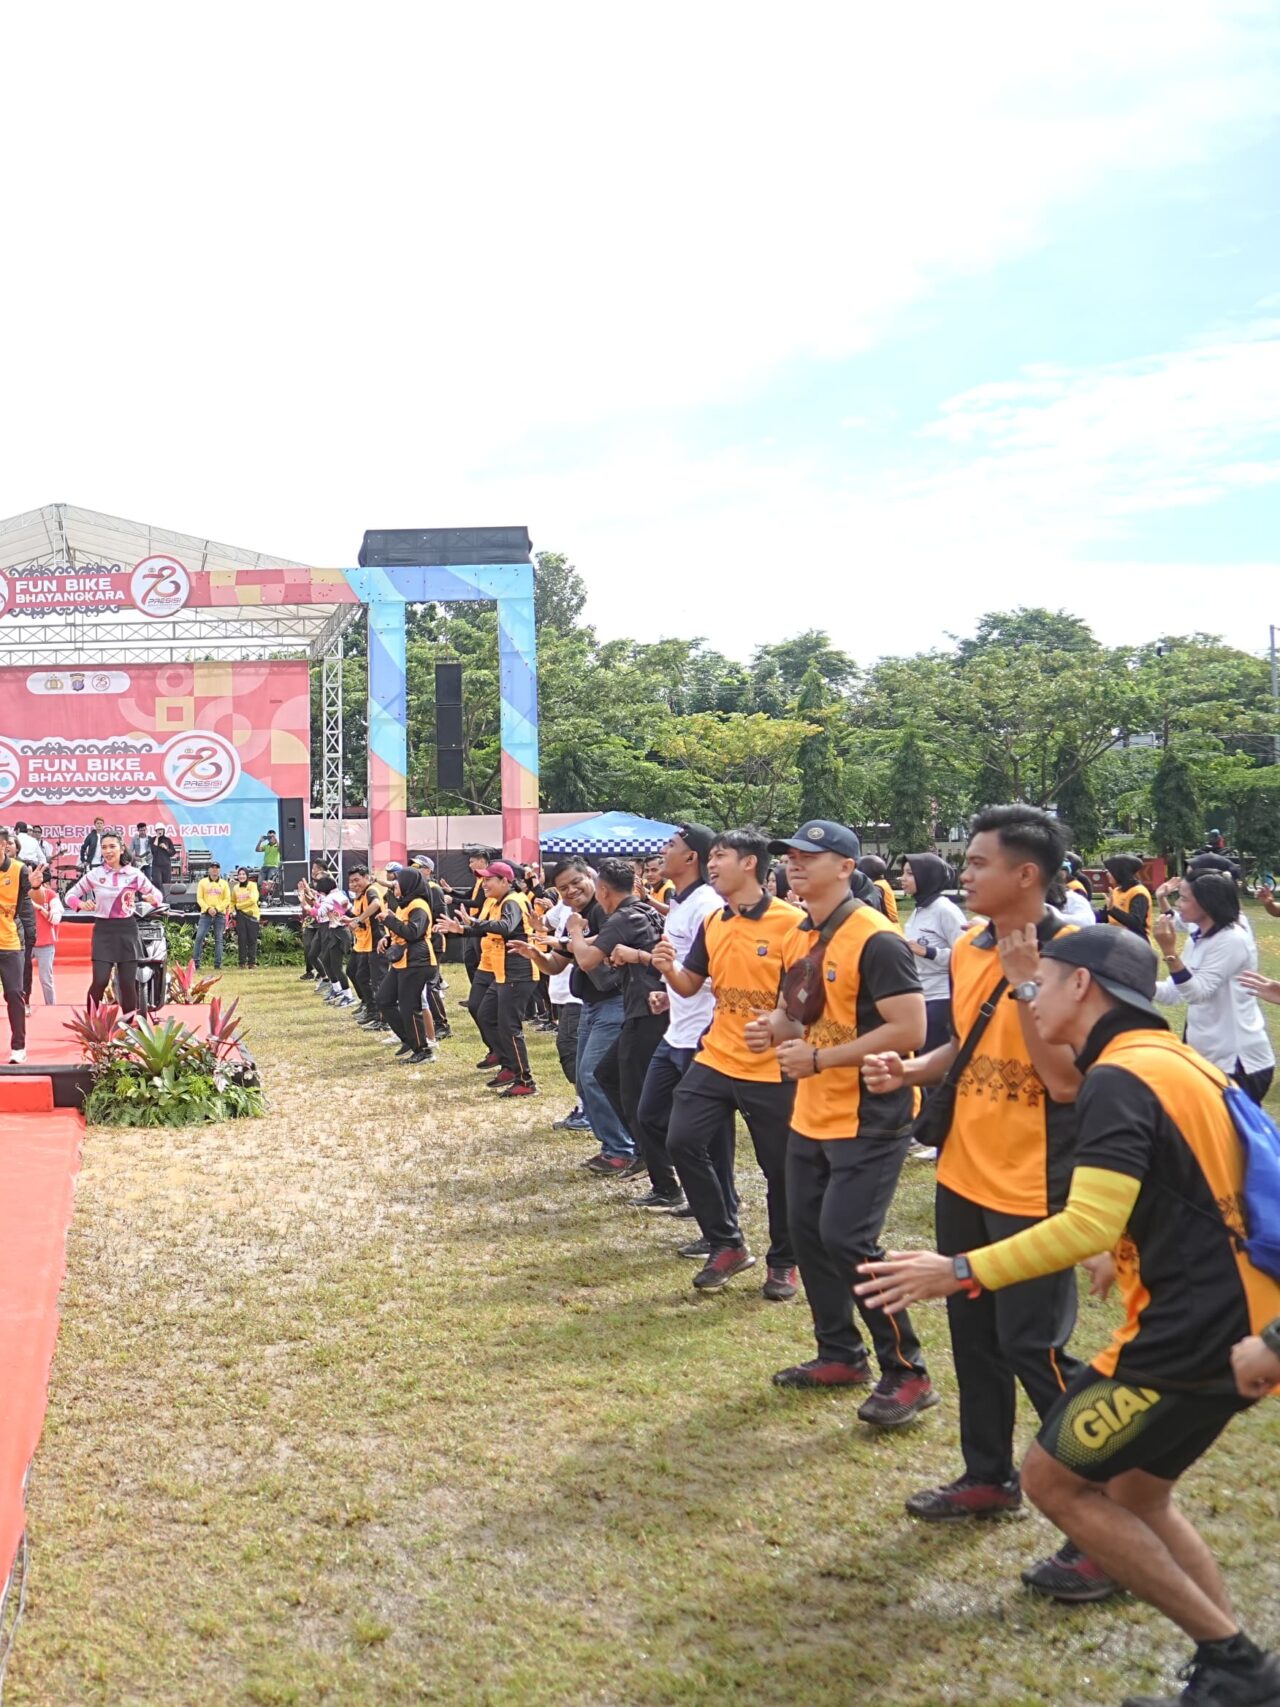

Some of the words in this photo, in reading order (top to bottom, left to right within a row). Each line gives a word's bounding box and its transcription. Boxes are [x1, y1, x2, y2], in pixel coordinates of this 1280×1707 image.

[15, 579, 57, 593] FUN
[65, 577, 112, 591] BIKE
[15, 591, 125, 604] BHAYANGKARA
[28, 758, 77, 772] FUN
[87, 757, 141, 771] BIKE
[28, 771, 156, 783] BHAYANGKARA
[181, 824, 230, 836] KALTIM
